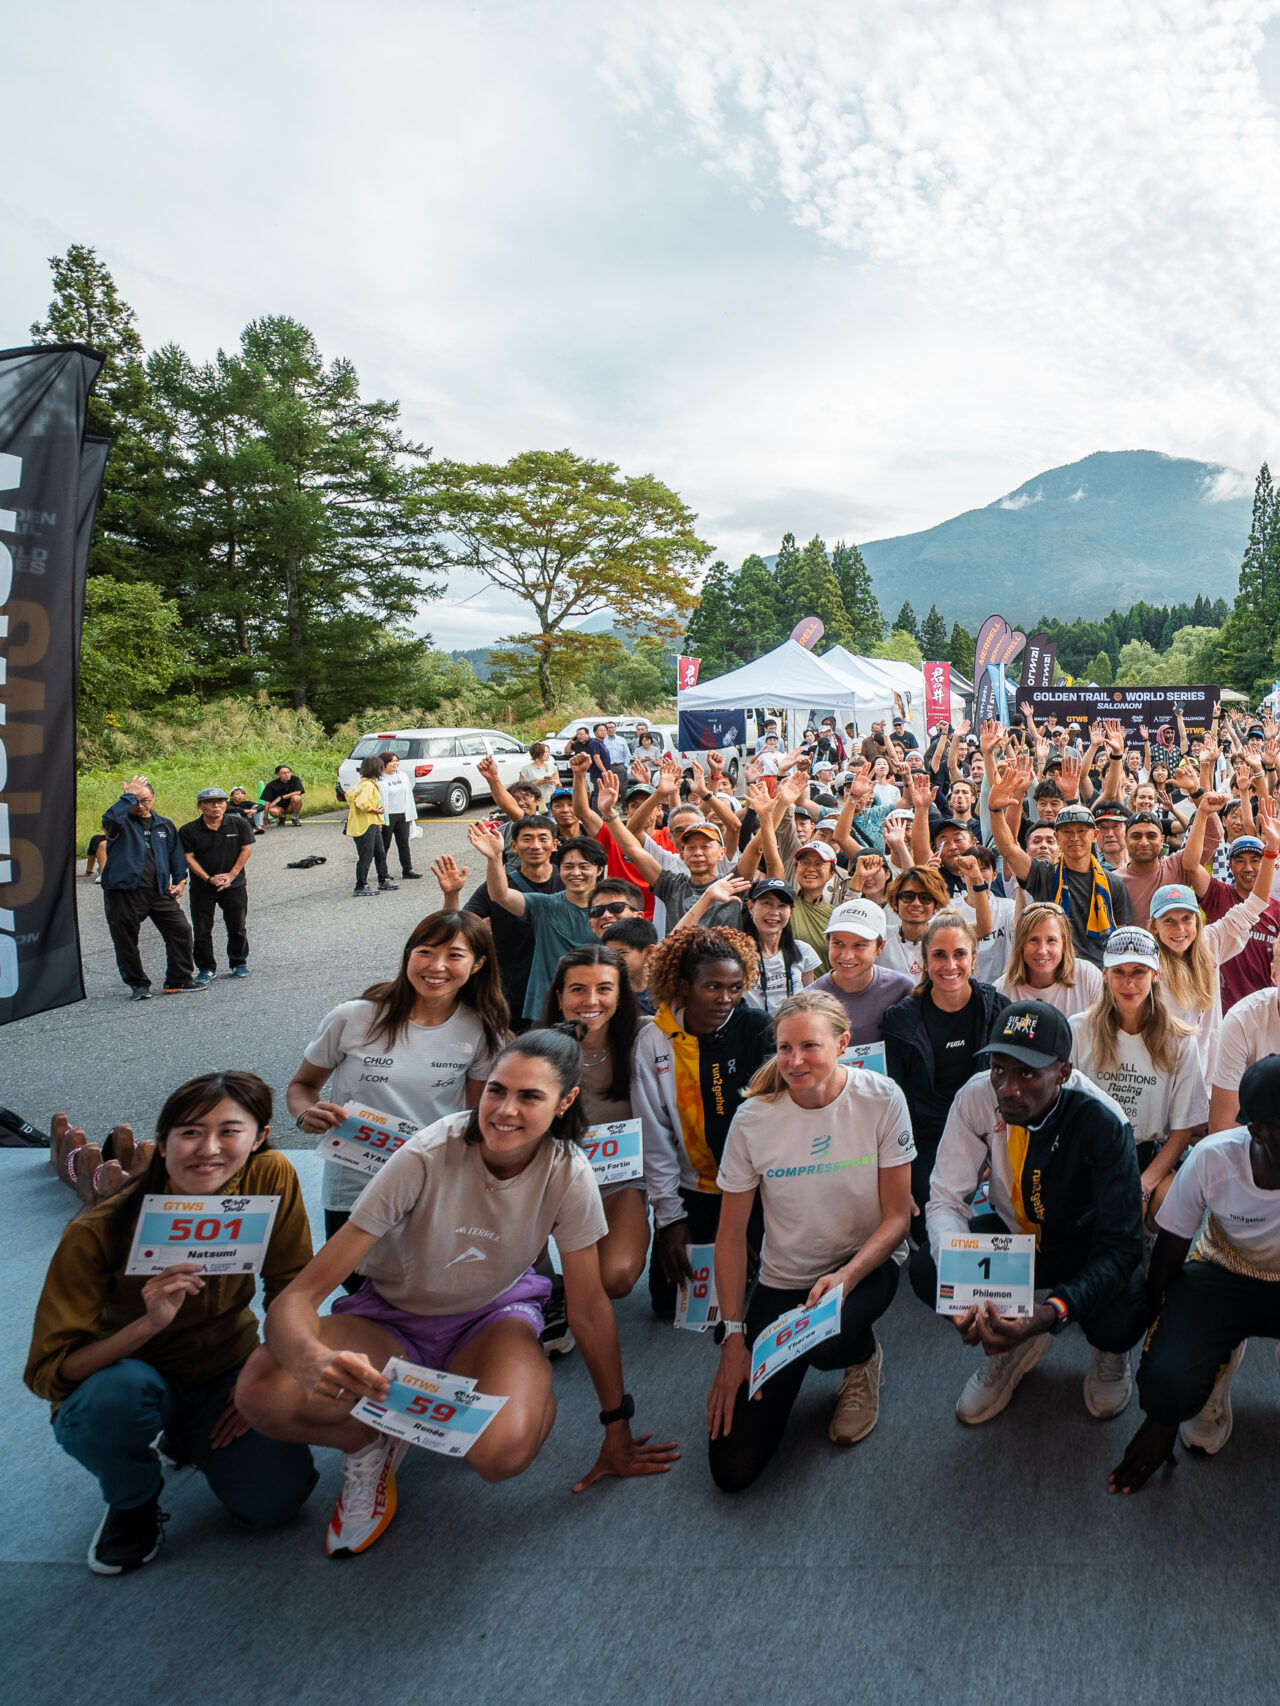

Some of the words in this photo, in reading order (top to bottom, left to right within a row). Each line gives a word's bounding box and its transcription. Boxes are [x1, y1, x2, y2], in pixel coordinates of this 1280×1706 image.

[979, 622, 1001, 666] MERRELL
[930, 666, 945, 705] 君の井
[1033, 691, 1077, 702] GOLDEN
[1079, 692, 1111, 702] TRAIL
[1125, 691, 1165, 702] WORLD
[1166, 691, 1206, 701] SERIES
[1096, 702, 1143, 710] SALOMON
[1066, 715, 1089, 723] GTWS
[945, 1040, 965, 1048] FUGA
[363, 1056, 394, 1066] CHUO
[1118, 1062, 1137, 1073] ALL
[1096, 1071, 1157, 1086] CONDITIONS
[711, 1062, 726, 1116] run2gether
[1107, 1082, 1143, 1096] Racing
[358, 1109, 389, 1126] GTWS
[353, 1124, 408, 1154] 533
[584, 1139, 619, 1160] 70
[607, 1160, 631, 1172] Fortin
[766, 1152, 878, 1179] COMPRESSPORT
[163, 1201, 205, 1211] GTWS
[168, 1218, 243, 1241] 501
[951, 1238, 980, 1249] GTWS
[187, 1249, 238, 1259] Natsumi
[977, 1257, 991, 1280] 1
[693, 1266, 710, 1299] 66
[972, 1288, 1013, 1299] Philemon
[775, 1315, 810, 1348] 65
[402, 1373, 440, 1393] GTWS
[405, 1395, 457, 1423] 59
